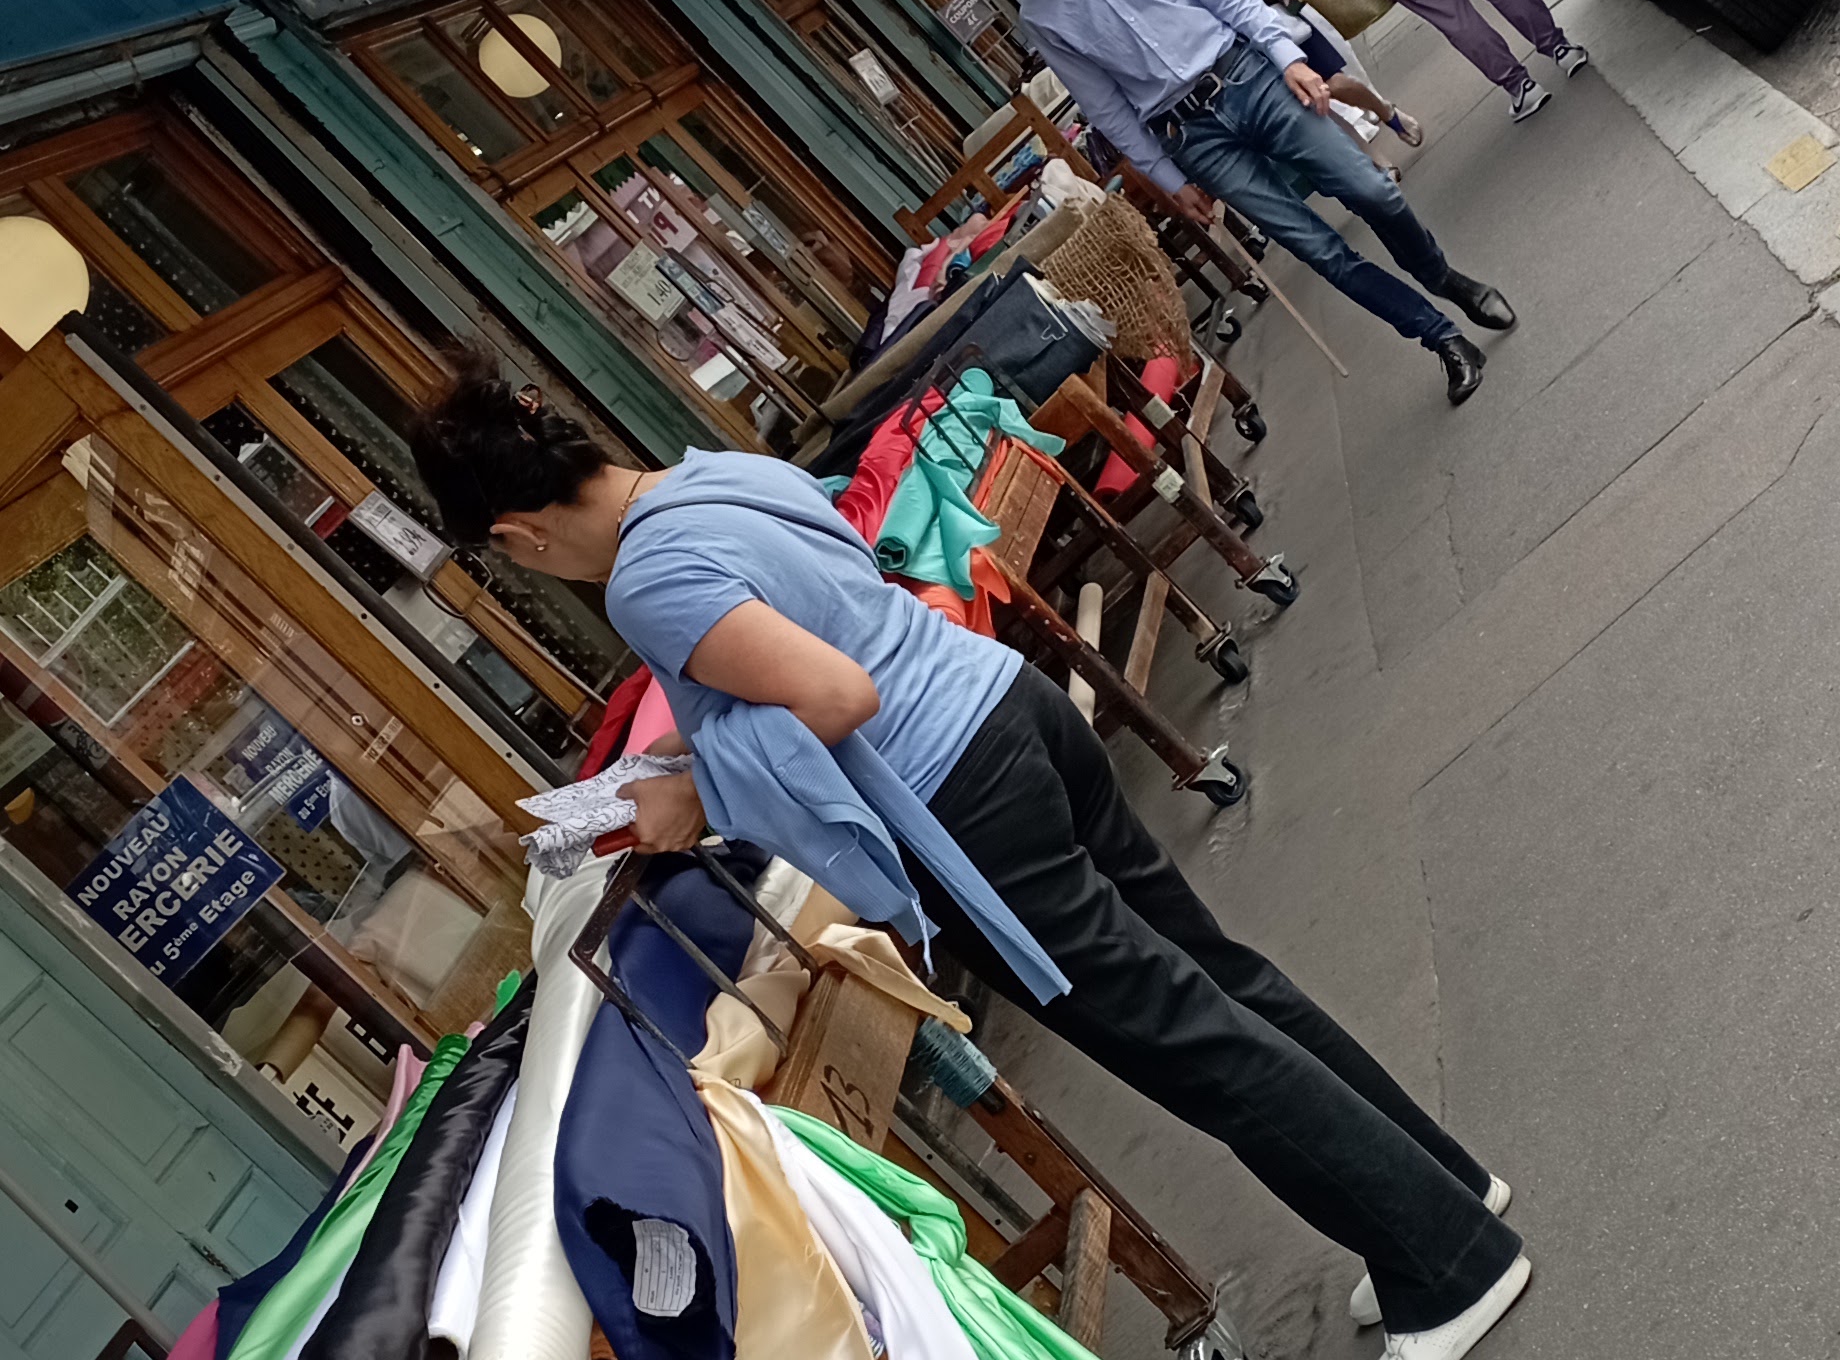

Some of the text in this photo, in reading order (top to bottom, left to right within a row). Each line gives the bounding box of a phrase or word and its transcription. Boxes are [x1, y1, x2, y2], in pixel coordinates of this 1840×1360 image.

[241, 724, 278, 762] NOUVEAU
[265, 746, 297, 777] RAYON
[268, 748, 324, 806] MERCERIE
[77, 812, 170, 907] NOUVEAU
[112, 846, 188, 921] RAYON
[117, 828, 244, 953] ERCERIE
[163, 921, 199, 960] 5ème
[198, 870, 256, 925] Etage
